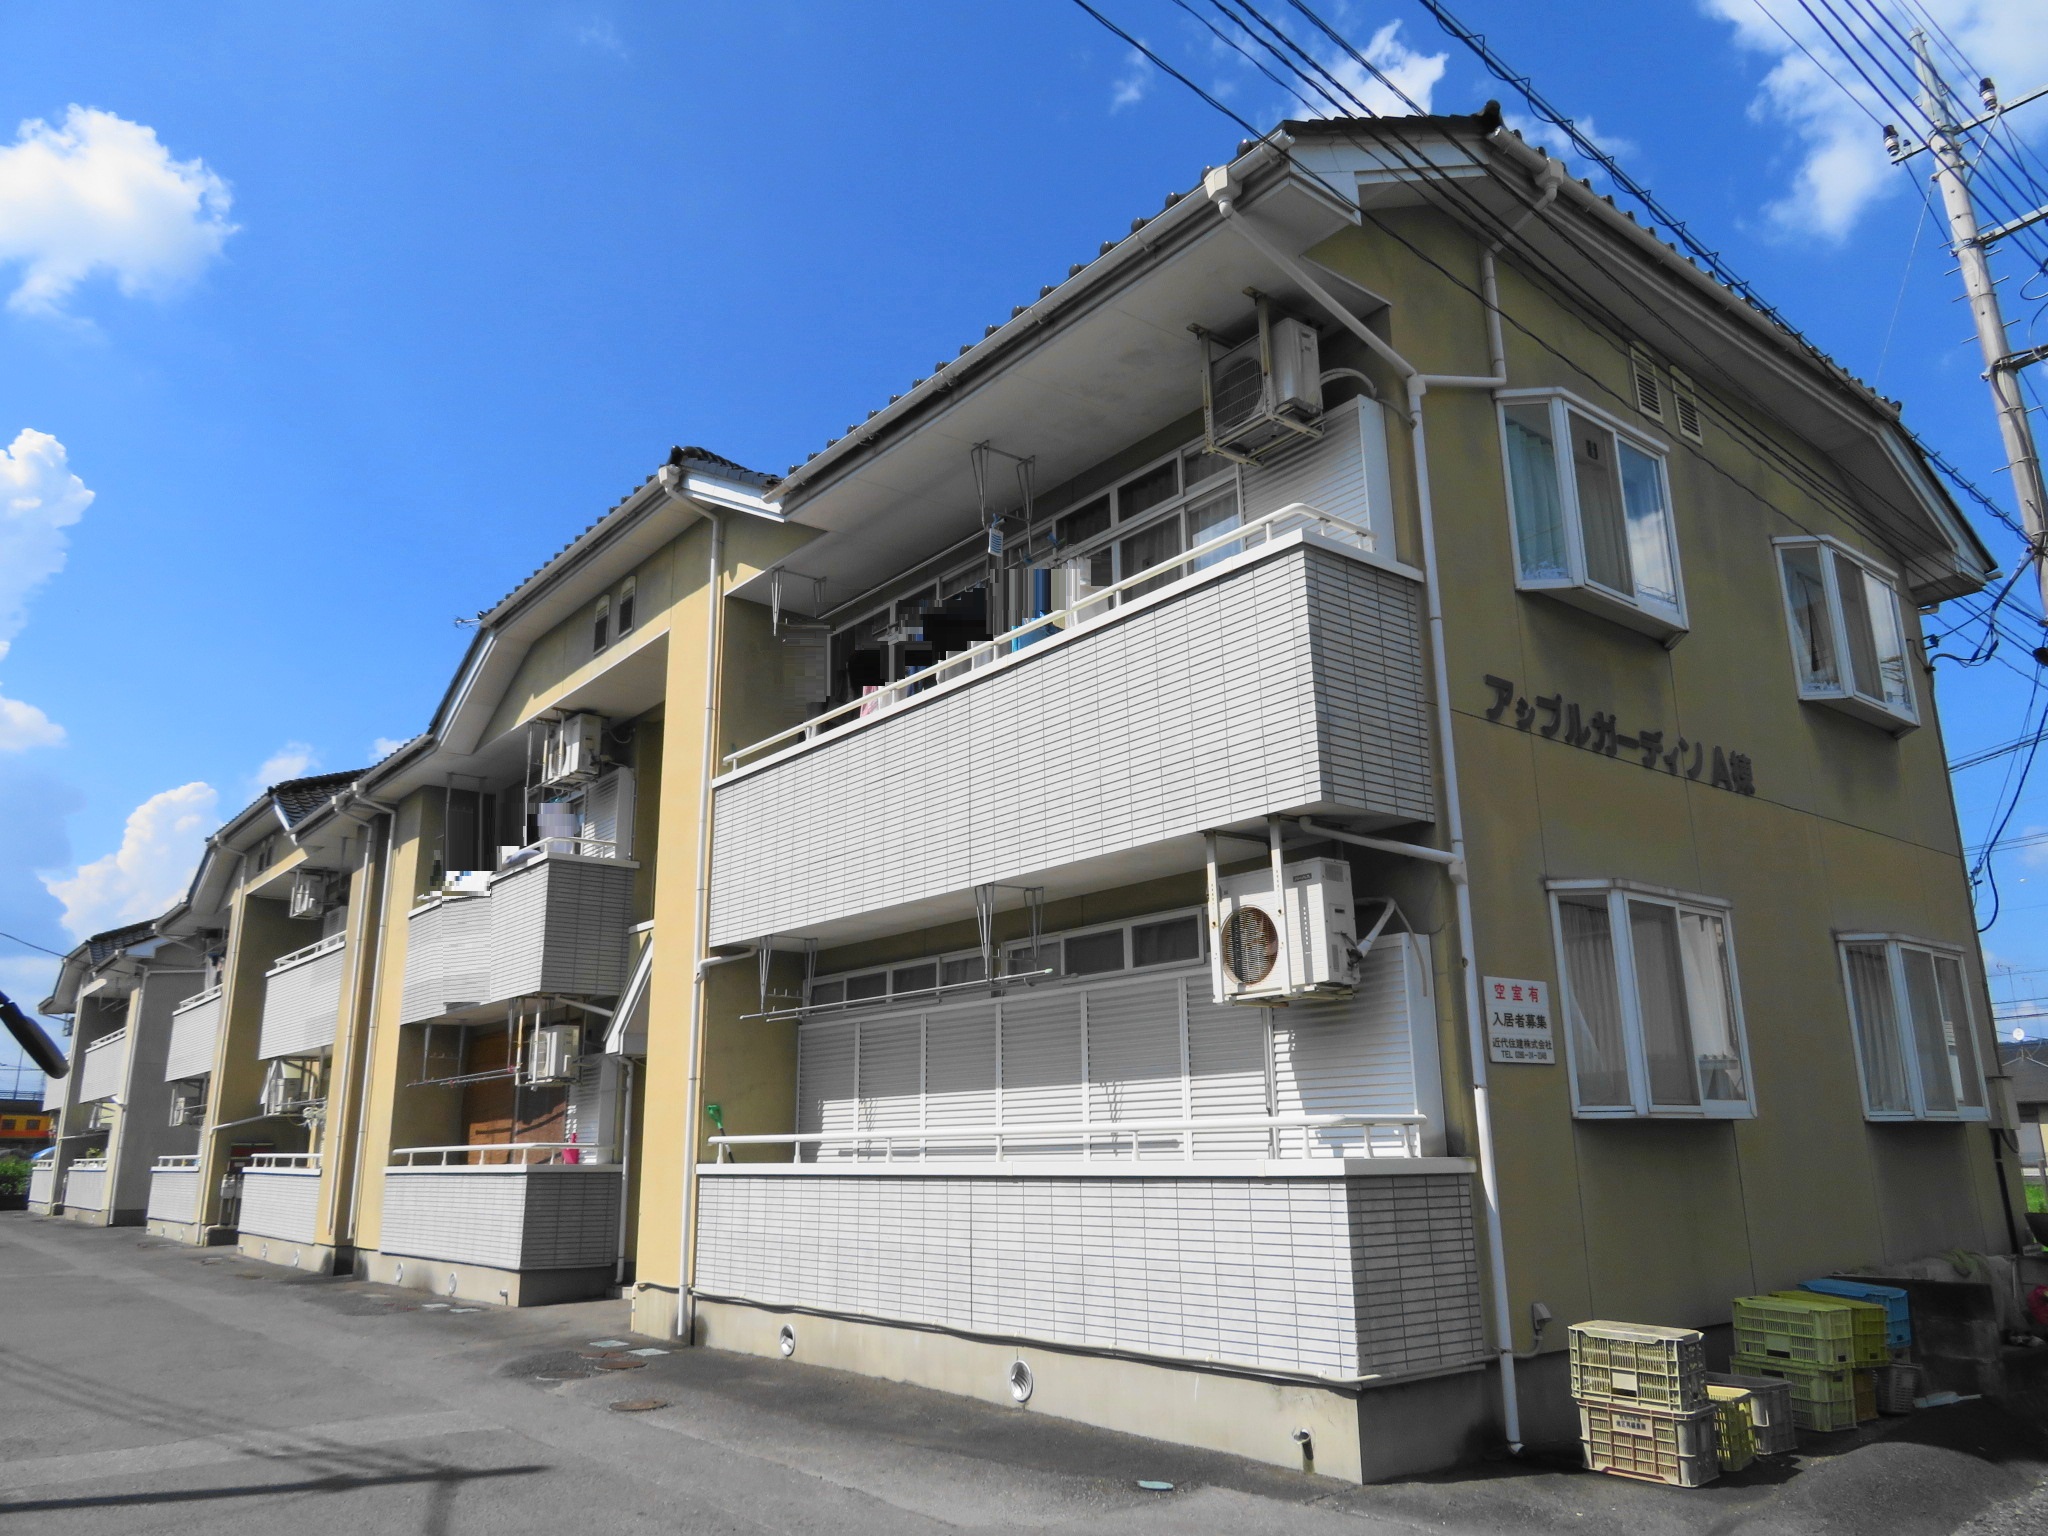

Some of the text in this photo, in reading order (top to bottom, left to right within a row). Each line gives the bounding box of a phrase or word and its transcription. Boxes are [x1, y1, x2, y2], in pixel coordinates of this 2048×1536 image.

[1494, 983, 1539, 1003] 空室有
[1492, 1012, 1547, 1029] 入居者募集
[1492, 1037, 1552, 1050] 近代住建株式会社
[1501, 1050, 1513, 1059] TEL
